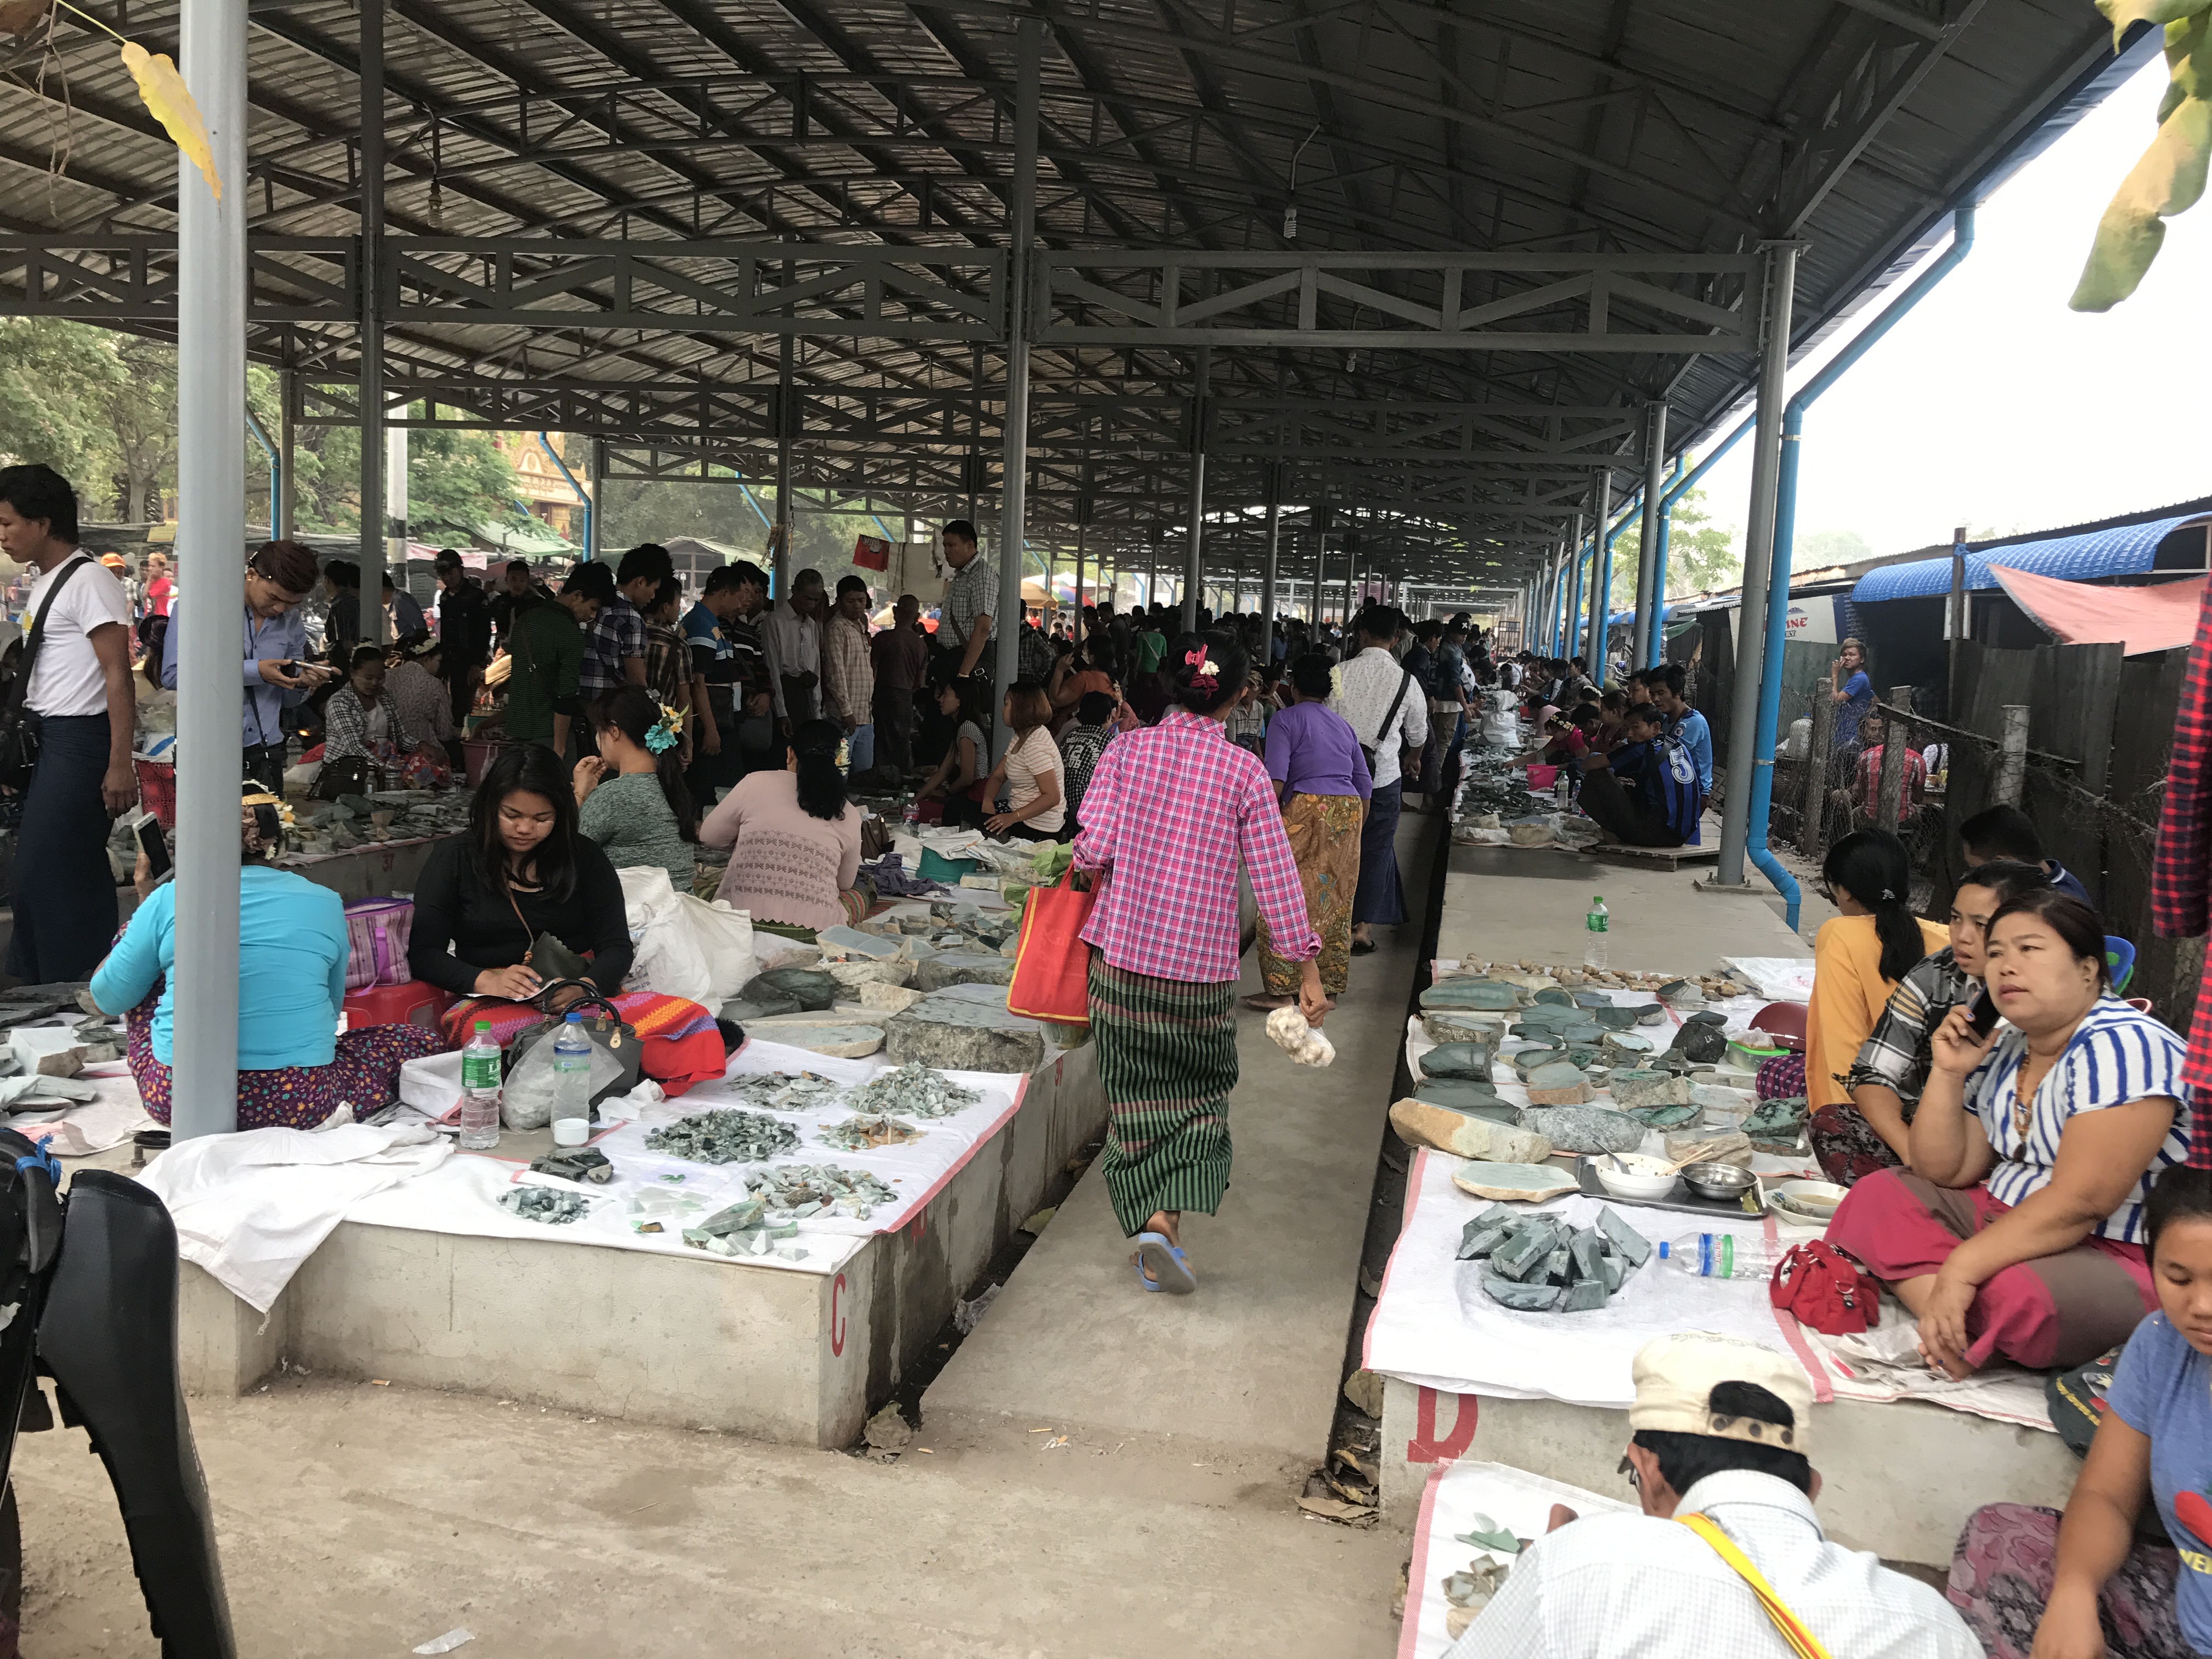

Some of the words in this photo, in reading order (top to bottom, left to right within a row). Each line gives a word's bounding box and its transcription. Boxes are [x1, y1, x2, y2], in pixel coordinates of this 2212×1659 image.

[1785, 617, 1808, 629] INE
[1668, 745, 1695, 785] 5
[1713, 1241, 1724, 1265] Lucky
[832, 1273, 846, 1358] C
[1407, 1385, 1479, 1464] D
